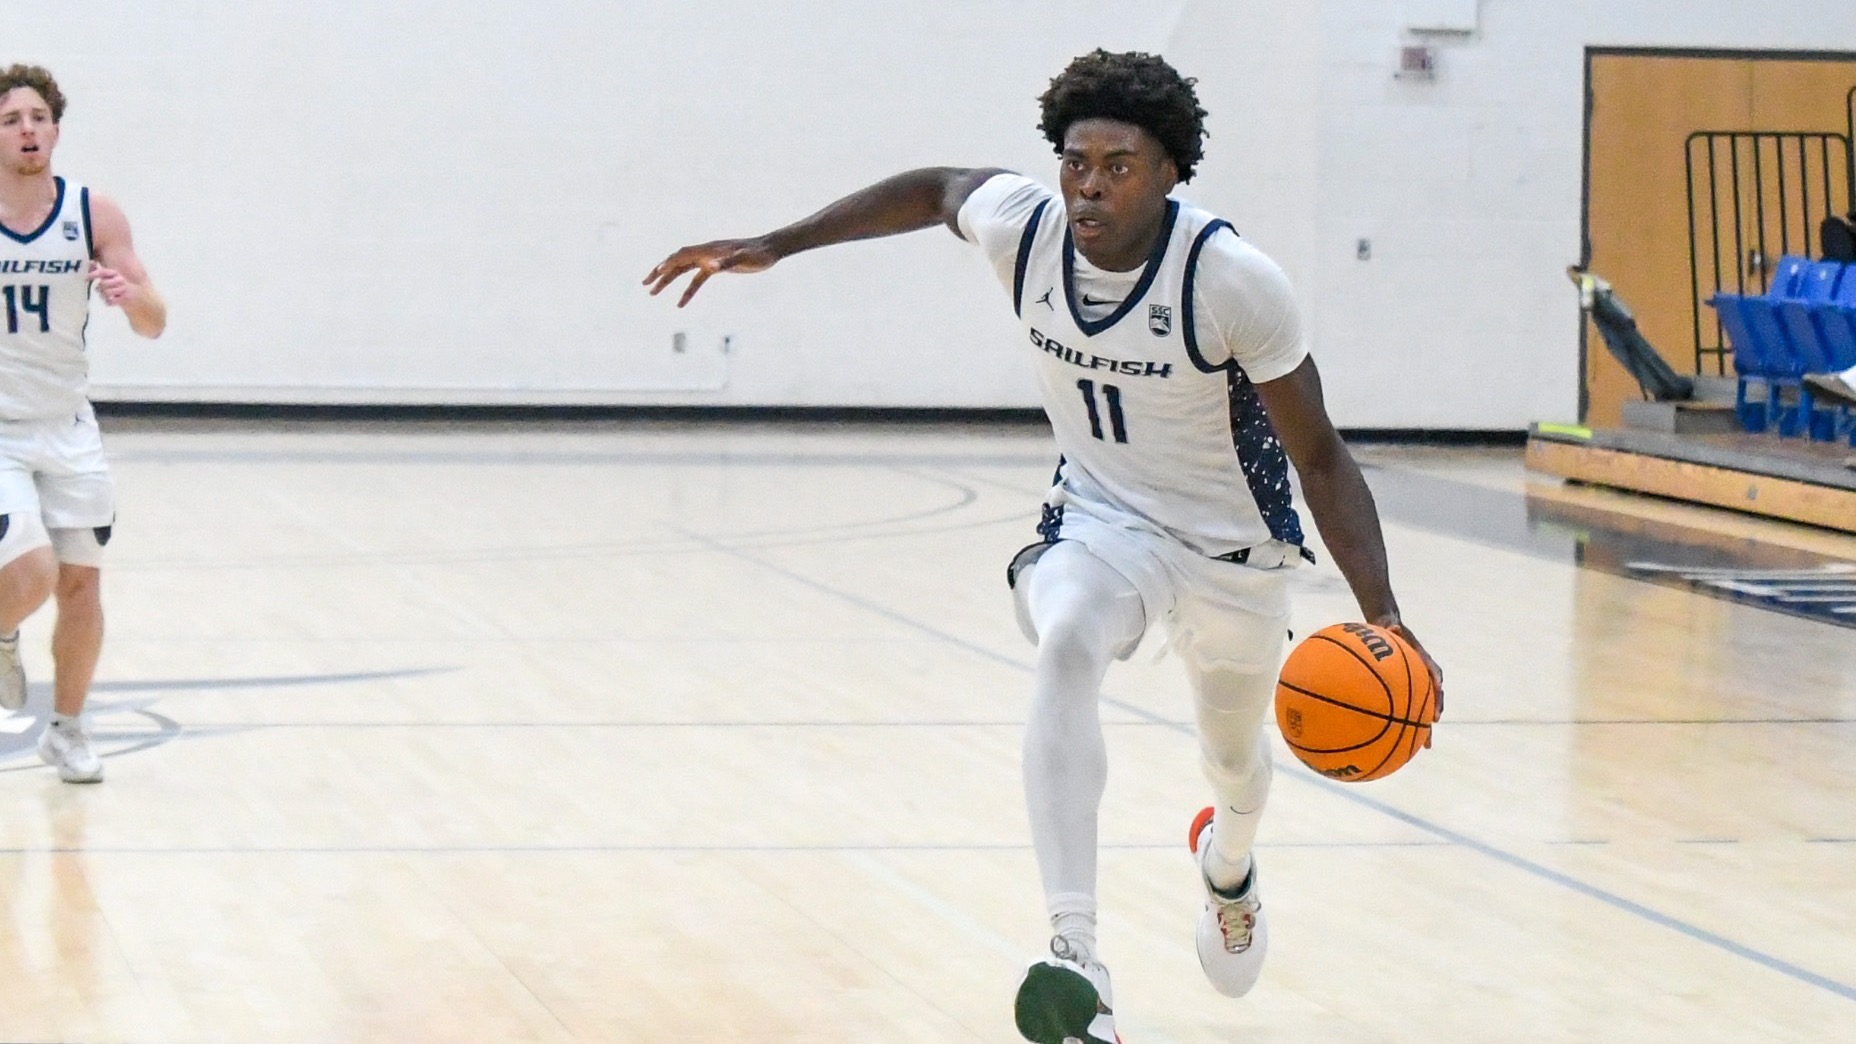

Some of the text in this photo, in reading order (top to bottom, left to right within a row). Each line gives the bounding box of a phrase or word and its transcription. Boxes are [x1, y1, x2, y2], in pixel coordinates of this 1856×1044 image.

[0, 260, 81, 273] ILFISH
[2, 285, 50, 333] 14
[1151, 306, 1169, 316] SSC
[1029, 327, 1173, 379] SAILFISH
[1076, 378, 1128, 443] 11
